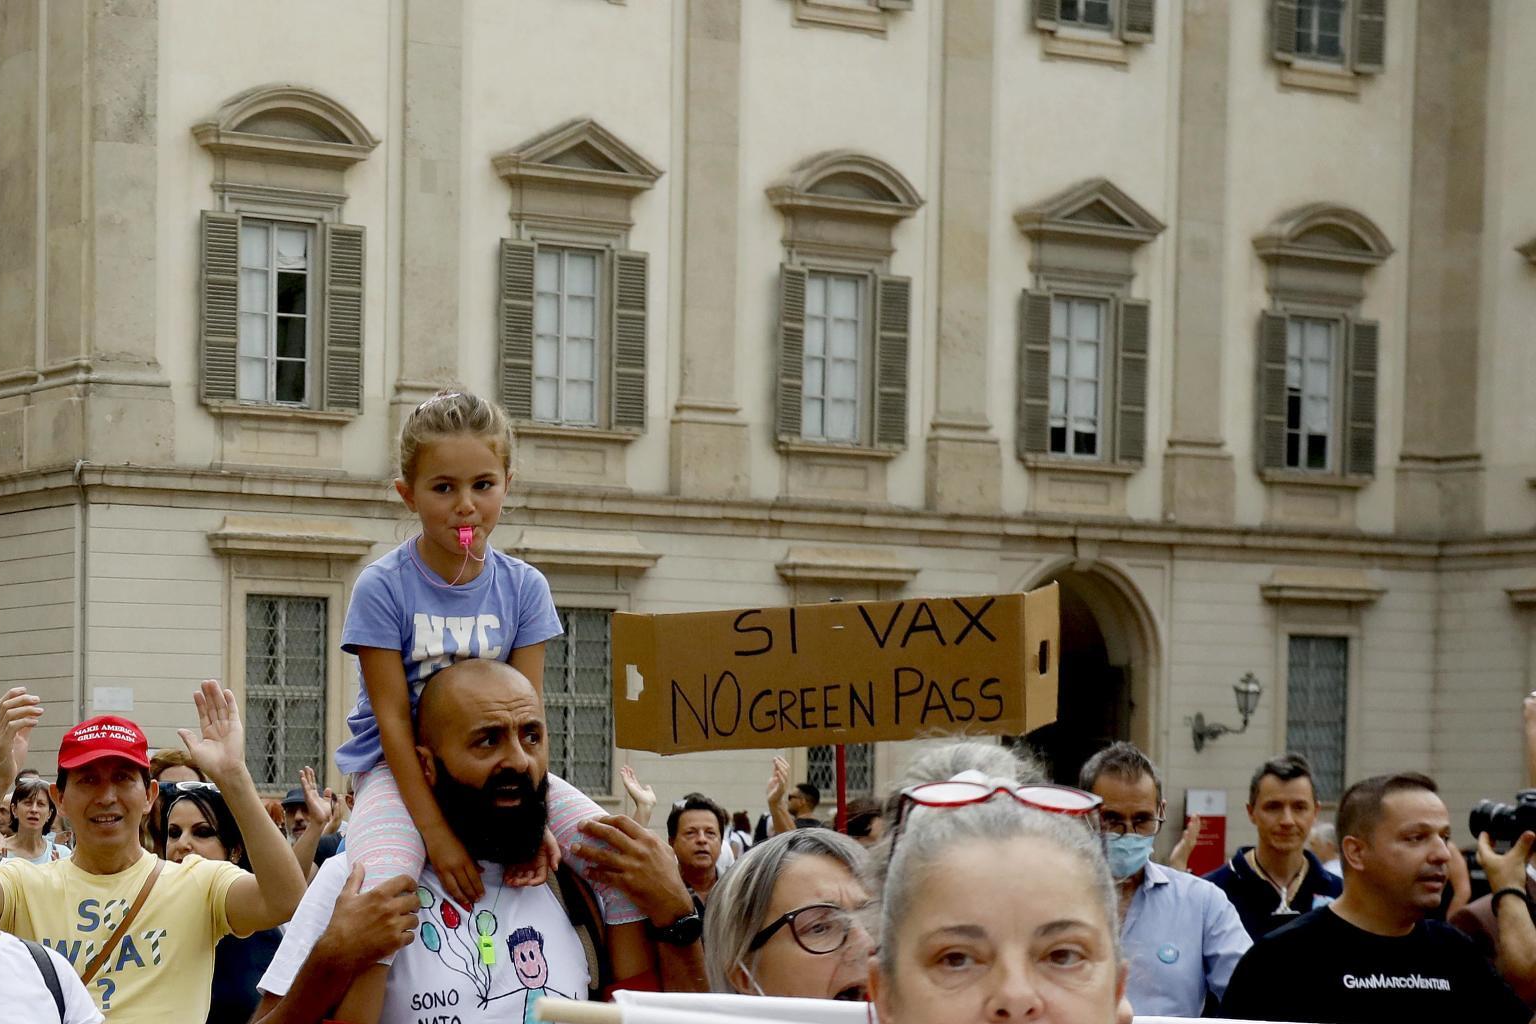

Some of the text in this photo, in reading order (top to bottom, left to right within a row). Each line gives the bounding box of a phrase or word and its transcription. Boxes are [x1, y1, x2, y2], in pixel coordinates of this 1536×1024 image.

[411, 613, 502, 661] NYC
[733, 597, 997, 657] SI VAX
[893, 666, 1004, 725] PASS
[74, 724, 137, 738] MAKE AMERICA
[77, 732, 135, 743] GREAT AGAIN
[76, 898, 130, 932] SO
[96, 977, 116, 1010] ?
[410, 988, 460, 1011] SONO
